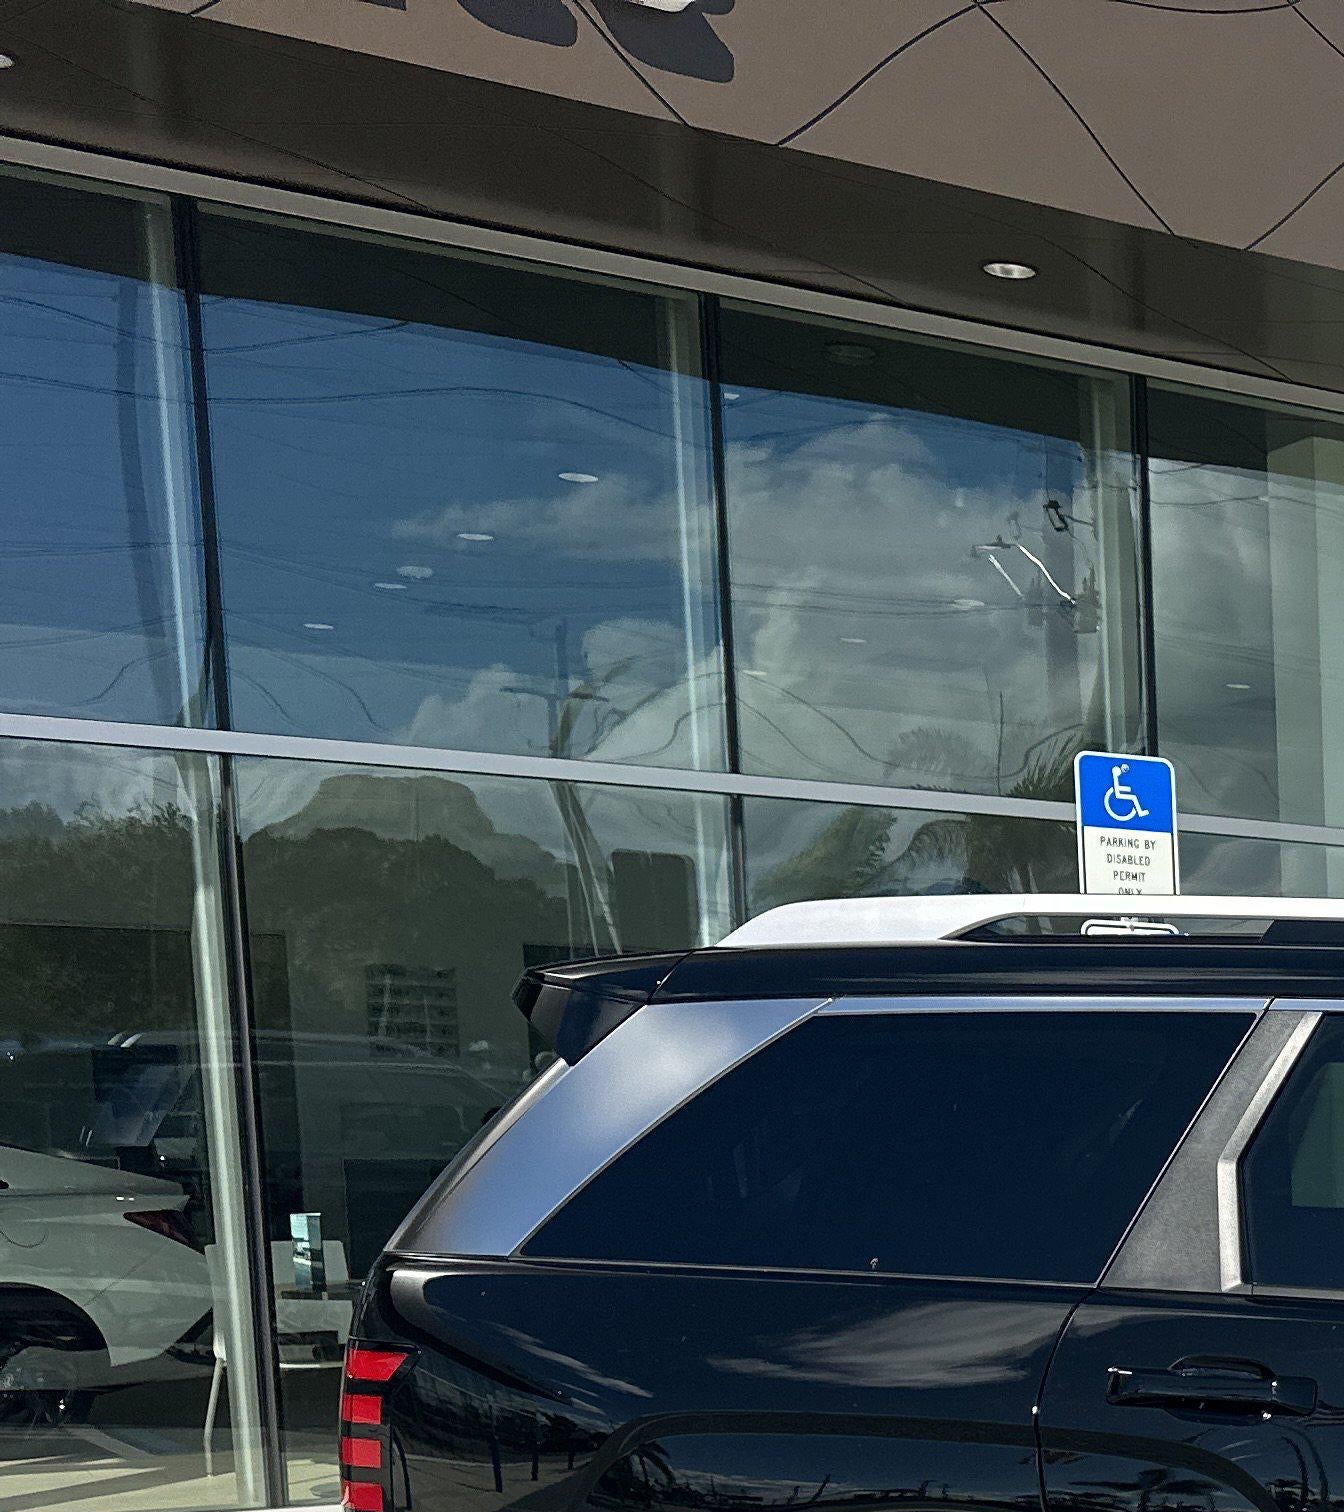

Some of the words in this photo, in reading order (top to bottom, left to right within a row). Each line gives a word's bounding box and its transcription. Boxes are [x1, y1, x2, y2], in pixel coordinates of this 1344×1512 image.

[1100, 836, 1140, 849] PARKING
[1144, 839, 1156, 850] BY
[1106, 853, 1151, 866] DISABLED
[1113, 870, 1146, 882] PERMIT
